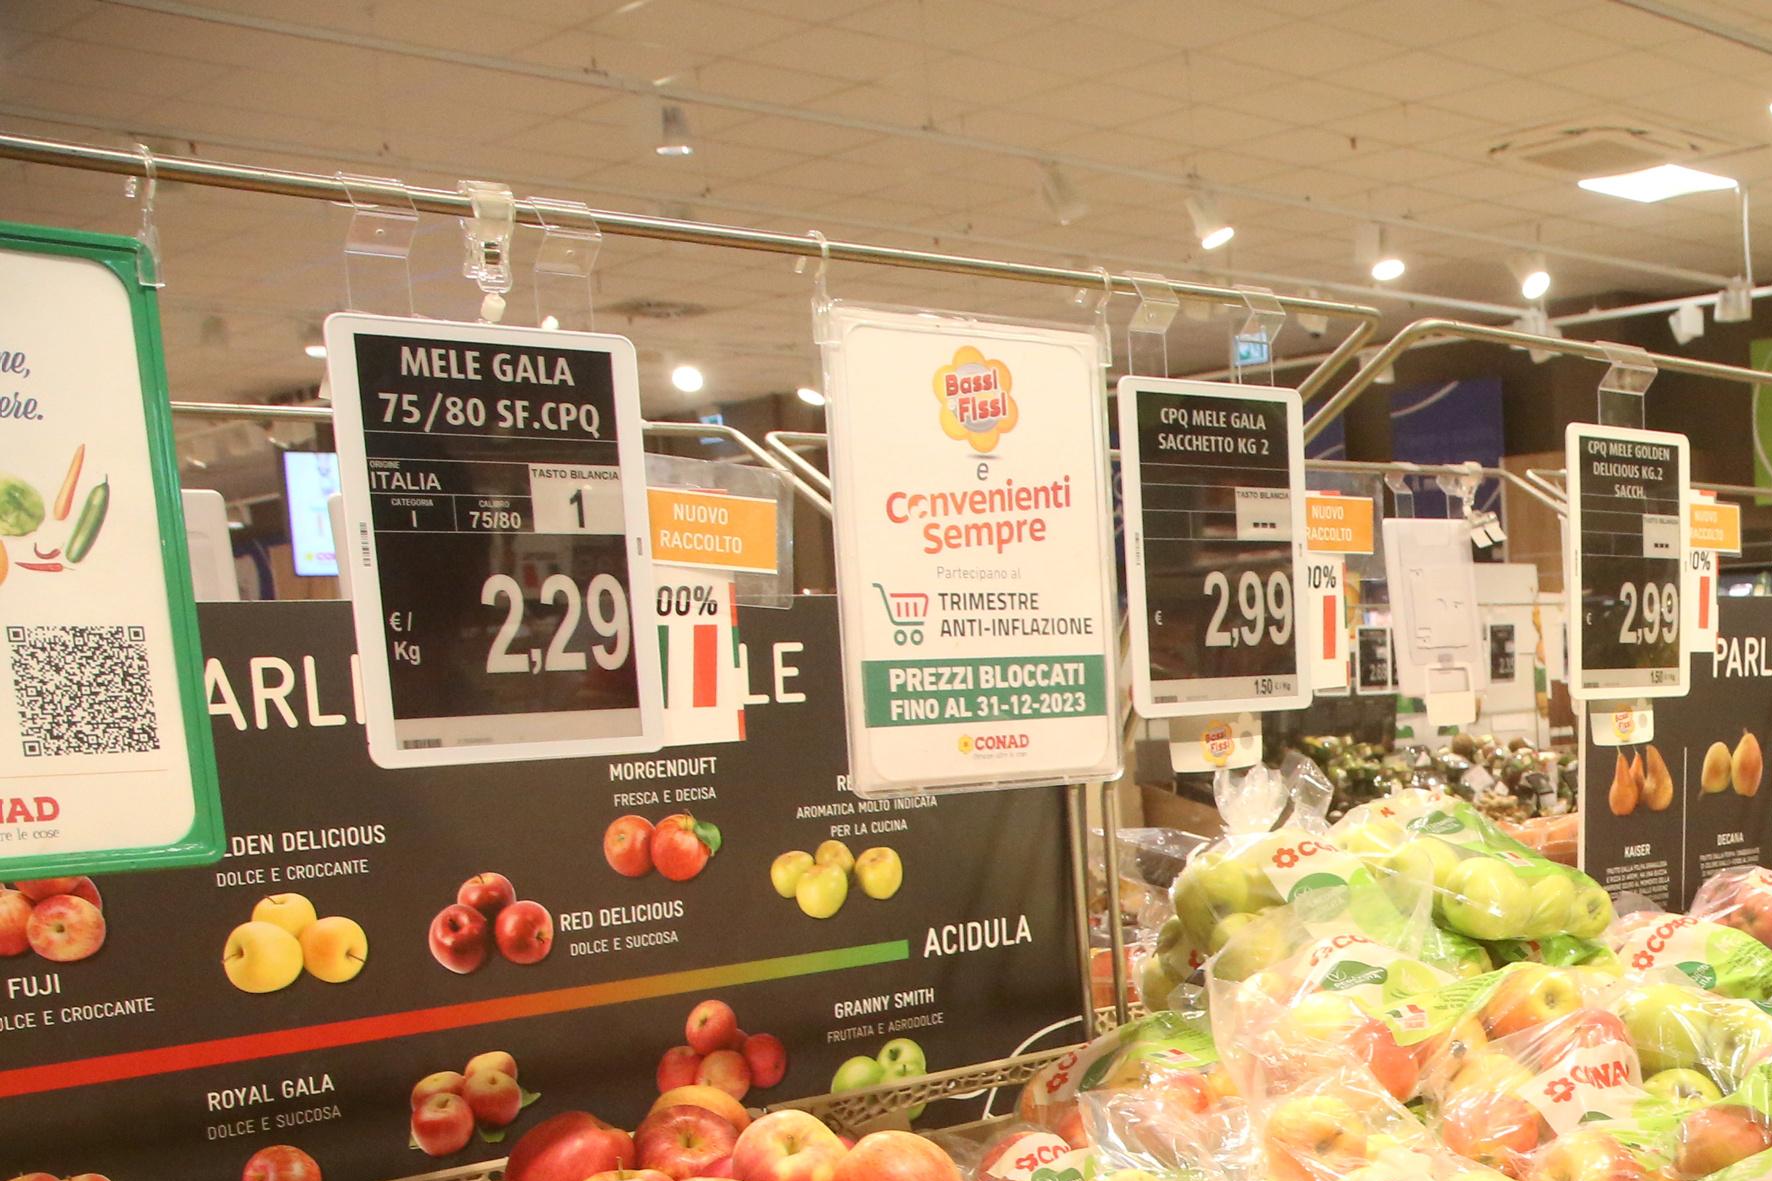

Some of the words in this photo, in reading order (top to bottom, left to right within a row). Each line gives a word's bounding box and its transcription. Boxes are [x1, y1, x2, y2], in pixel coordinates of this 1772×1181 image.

[400, 345, 483, 382] MELE
[492, 352, 575, 386] GALA
[944, 369, 998, 397] Bassi
[377, 391, 486, 433] 75/80
[496, 399, 601, 439] SF.CPQ
[958, 392, 1008, 423] Fissi
[1160, 407, 1189, 429] CPQ
[1192, 409, 1227, 428] MELE
[1231, 412, 1267, 431] GALA
[1157, 432, 1235, 454] SACCHETTO
[1237, 437, 1257, 454] KG
[1260, 438, 1270, 455] 2
[1587, 440, 1607, 458] CPQ
[1609, 442, 1633, 459] MELE
[1635, 446, 1670, 462] GOLDEN
[369, 460, 401, 470] ORIGINE
[531, 468, 568, 480] TASTO
[570, 469, 620, 481] BILANCIA
[976, 462, 989, 481] e
[1592, 461, 1640, 479] DELICIOUS
[369, 470, 442, 491] ITALIA
[390, 497, 434, 507] CATEGORIA
[569, 489, 586, 528] 1
[885, 475, 1071, 524] Convenienti
[1311, 504, 1345, 521] NUOVO
[469, 510, 522, 529] 75/80
[673, 503, 729, 526] NUOVO
[659, 529, 743, 554] RACCOLTO
[923, 517, 1047, 555] Sempre
[936, 565, 1008, 581] Partecipano
[1010, 567, 1022, 580] al
[938, 592, 1040, 612] TRIMESTRE
[1203, 570, 1293, 649] 2,99
[1619, 581, 1679, 645] 2,99
[389, 612, 403, 632] €
[480, 572, 631, 675] 2,29
[940, 617, 1093, 638] ANTI-INFLAZIONE
[1154, 610, 1164, 626] €
[394, 641, 422, 665] Kg
[889, 665, 974, 693] PREZZI
[979, 662, 1085, 688] BLOCCATI
[890, 698, 940, 721] FINO
[944, 696, 973, 718] AL
[976, 692, 1086, 717] 31-12-2023
[974, 734, 1030, 750] CONAD
[609, 756, 717, 782] MORGENDUFT
[613, 790, 660, 807] FRESCA
[663, 789, 672, 803] E
[675, 786, 717, 802] DECISA
[796, 803, 855, 819] AROMATICA
[858, 799, 890, 814] MOLTO
[893, 795, 938, 810] INDICATA
[224, 833, 274, 857] DEN
[281, 824, 387, 852] DELICIOUS
[830, 824, 851, 838] PER
[854, 822, 868, 836] LA
[871, 819, 908, 834] CUCINA
[216, 869, 266, 888] DOLCE
[271, 867, 281, 883] E
[286, 859, 370, 881] CROCCANTE
[559, 911, 594, 932] RED
[599, 900, 685, 928] DELICIOUS
[569, 937, 609, 957] DOLCE
[613, 936, 622, 951] E
[625, 930, 680, 949] SUCCOSA
[923, 914, 1033, 959] ACIDULA
[7, 973, 61, 1000] FUJI
[43, 1010, 55, 1026] E
[61, 997, 156, 1024] CROCCANTE
[834, 995, 890, 1020] GRANNY
[894, 987, 935, 1010] SMITH
[826, 1024, 875, 1044] FRUTTATA
[877, 1023, 884, 1035] E
[888, 1012, 944, 1033] AGRODOLCE
[207, 1083, 275, 1112] ROYAL
[281, 1073, 336, 1100] GALA
[207, 1119, 256, 1141] DOLCE
[261, 1116, 271, 1132] E
[276, 1104, 342, 1129] SUCCOSA
